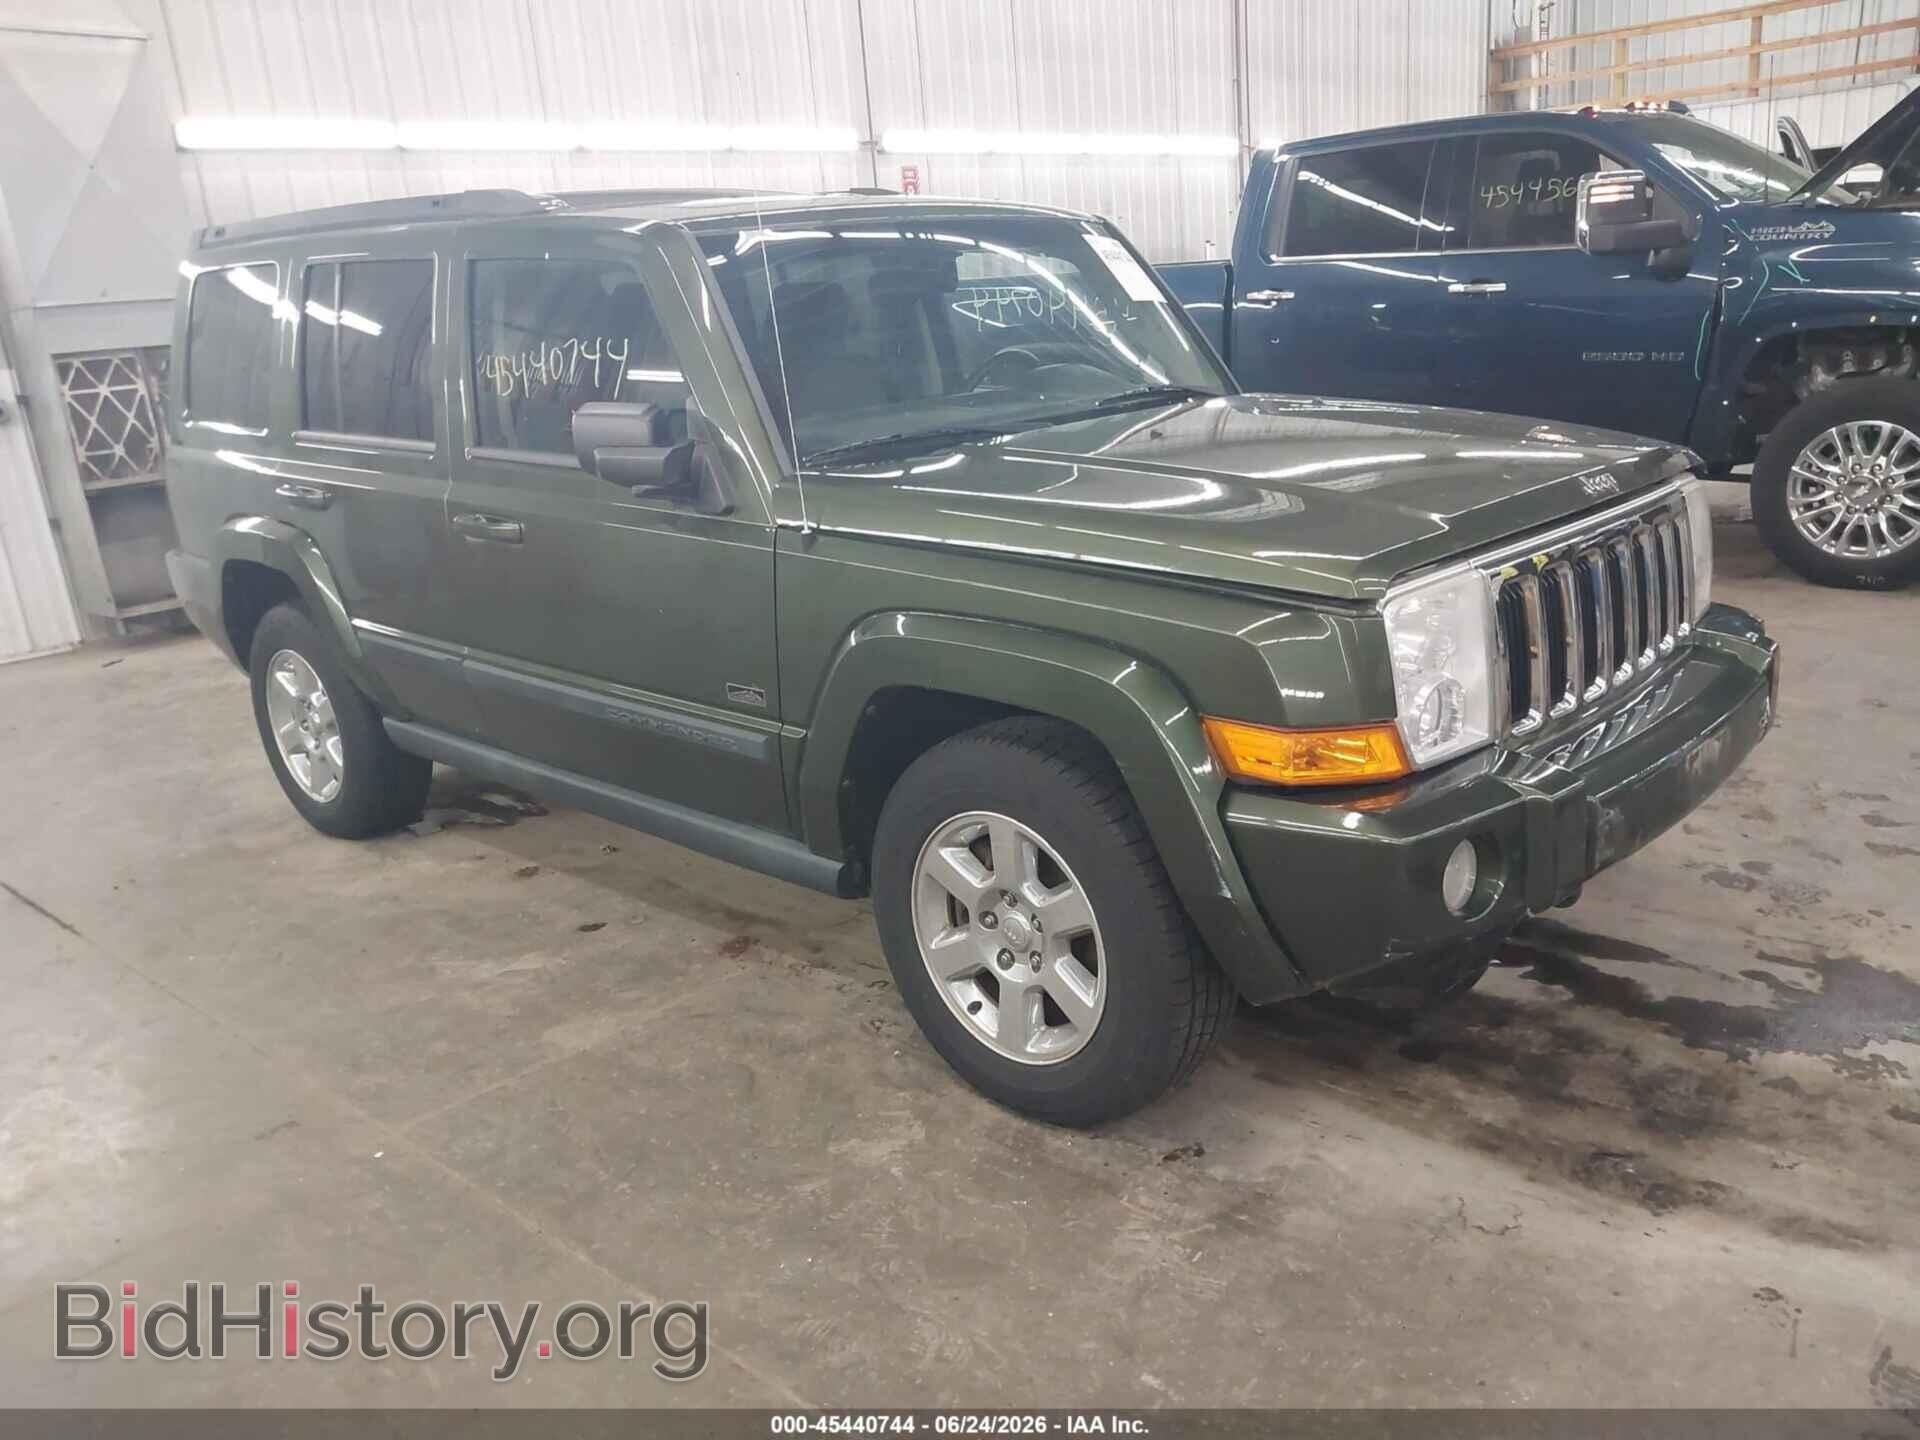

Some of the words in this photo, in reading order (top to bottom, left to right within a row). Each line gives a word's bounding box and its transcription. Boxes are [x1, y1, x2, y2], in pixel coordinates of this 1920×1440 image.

[1750, 231, 1833, 241] COUNTRY
[486, 336, 629, 399] 45440744
[1578, 472, 1619, 496] Jeep
